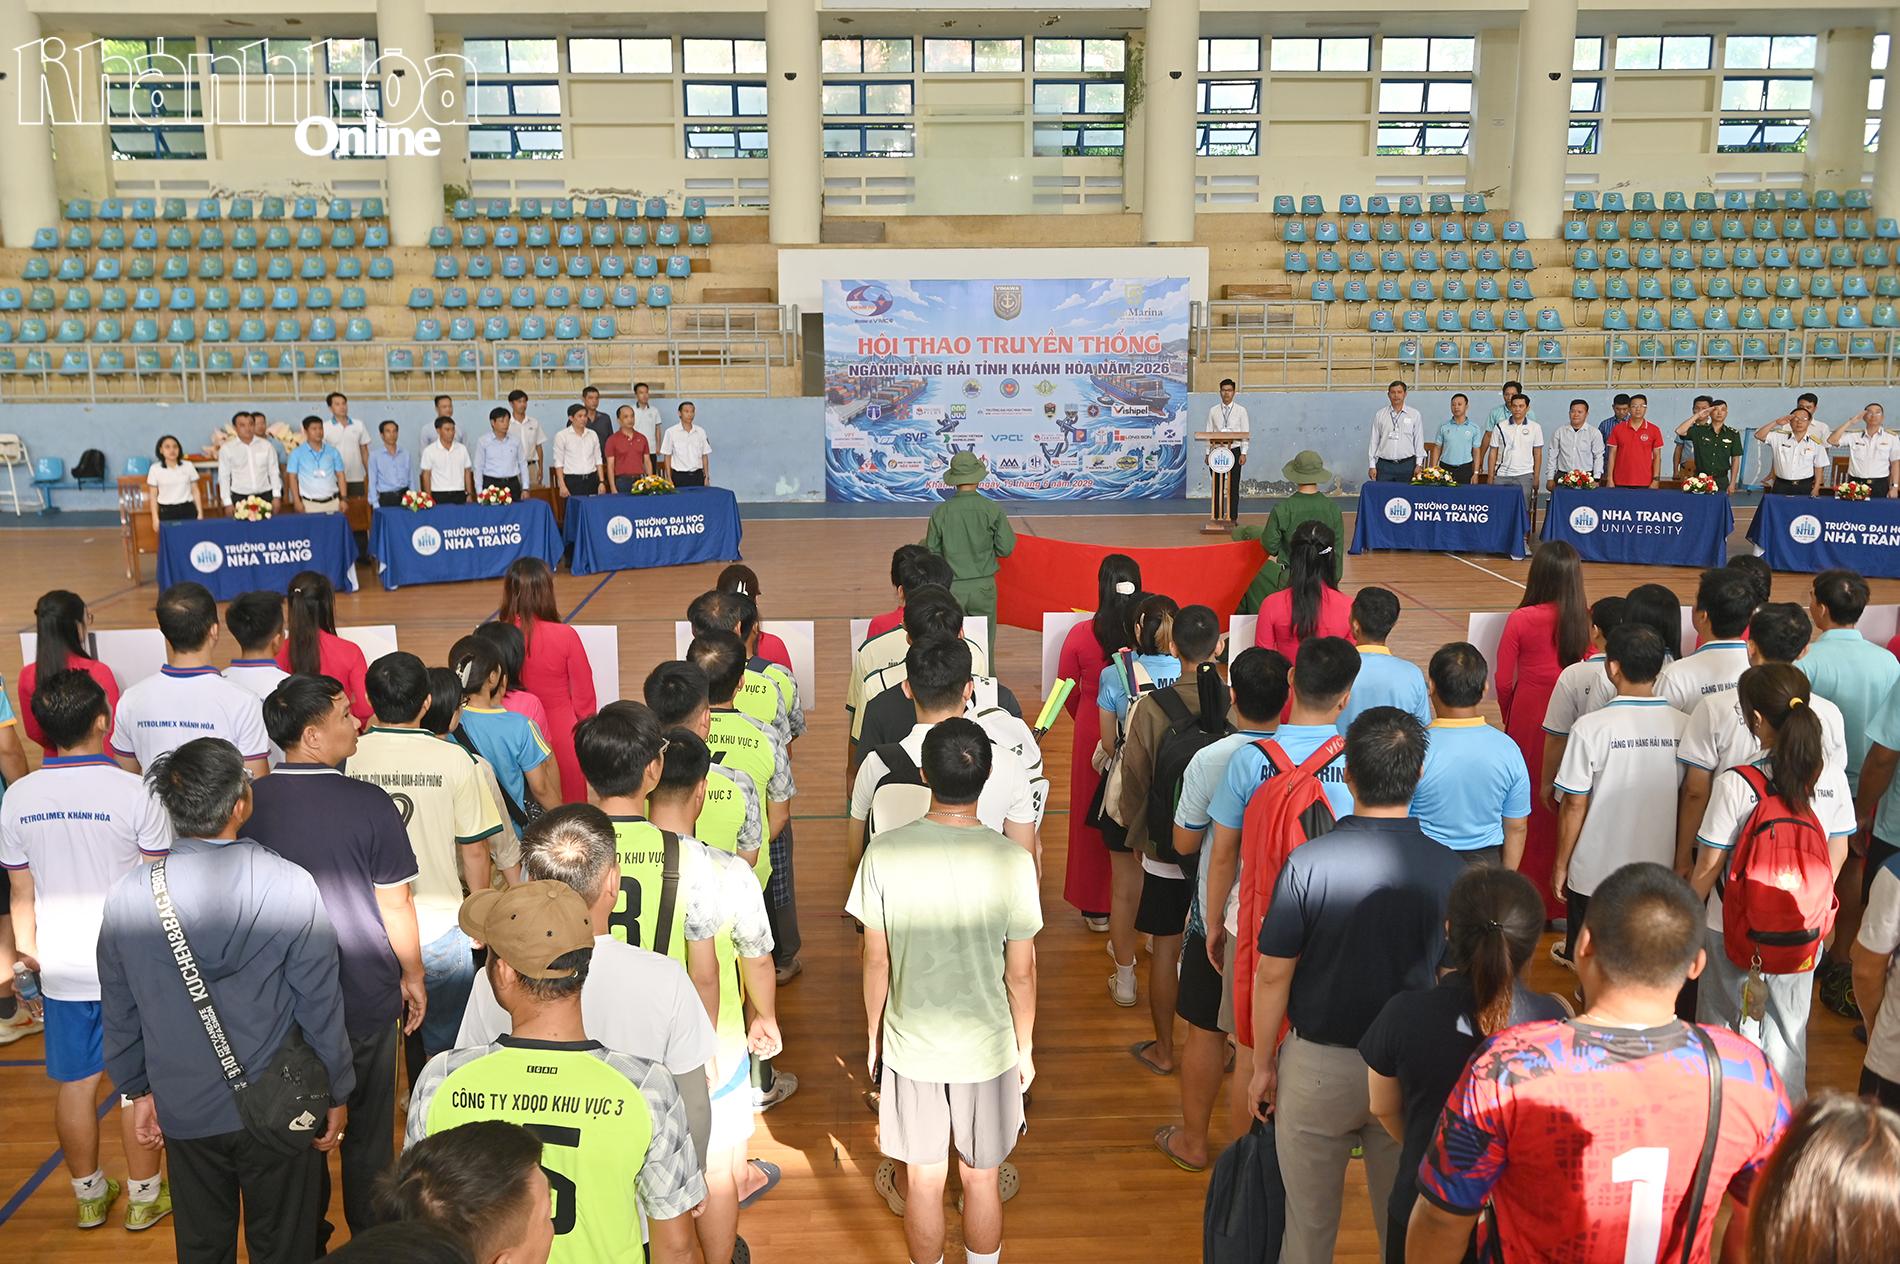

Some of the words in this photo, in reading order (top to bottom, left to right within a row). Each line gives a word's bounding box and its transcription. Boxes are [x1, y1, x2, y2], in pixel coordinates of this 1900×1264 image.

[1128, 307, 1163, 317] Marina
[858, 332, 898, 358] HỘI
[903, 336, 971, 354] THAO
[976, 328, 1073, 354] TRUYỀN
[1078, 328, 1162, 354] THỐNG
[849, 361, 898, 376] NGÀNH
[903, 361, 942, 376] HÀNG
[947, 360, 970, 375] HẢI
[974, 360, 1007, 375] TỈNH
[1012, 361, 1060, 375] KHÁNH
[1065, 361, 1093, 375] HÒA
[1098, 361, 1130, 375] NĂM
[1135, 363, 1169, 374] 2026
[904, 432, 928, 442] SVP
[1414, 501, 1449, 511] TRƯỜNG
[1451, 503, 1466, 512] ĐẠI
[1468, 504, 1489, 513] HỌC
[634, 516, 668, 527] TRƯỜNG
[669, 516, 684, 526] ĐẠI
[686, 514, 704, 525] HỌC
[1414, 511, 1441, 521] NHA
[1445, 512, 1489, 523] TRANG
[1602, 509, 1632, 521] NHA
[1636, 510, 1683, 522] TRANG
[443, 526, 480, 538] TRƯỜNG
[482, 525, 498, 536] ĐẠI
[499, 523, 520, 534] HỌC
[636, 526, 662, 539] NHA
[665, 523, 705, 536] TRANG
[1601, 523, 1683, 535] UNIVERSITY
[1825, 521, 1866, 532] TRƯỜNG
[1869, 524, 1887, 535] ĐẠI
[444, 538, 474, 550] NHA
[477, 532, 521, 547] TRANG
[1824, 531, 1857, 544] NHA
[225, 541, 266, 554] TRƯỜNG
[268, 540, 285, 553] ĐẠI
[288, 539, 311, 551] HỌC
[226, 553, 260, 567] NHA
[263, 548, 312, 565] TRANG
[762, 685, 767, 694] 3
[137, 720, 177, 729] PETROLIMEX
[179, 720, 199, 729] KHÁNH
[720, 735, 736, 744] KHU
[738, 736, 752, 749] VỰC
[753, 740, 759, 748] 3
[1660, 738, 1673, 748] NHA
[708, 789, 725, 803] VỰC
[726, 790, 732, 800] 3
[1817, 788, 1834, 798] TRANG
[20, 811, 65, 824] PETROLIMEX
[67, 811, 92, 820] KHÁNH
[624, 851, 645, 864] KHU
[452, 1087, 485, 1109] CÔNG
[490, 1093, 508, 1110] TY
[512, 1094, 548, 1113] XDQD
[552, 1095, 580, 1114] KHU
[585, 1097, 613, 1120] VỰC
[614, 1099, 625, 1116] 3
[1611, 1146, 1669, 1264] 1
